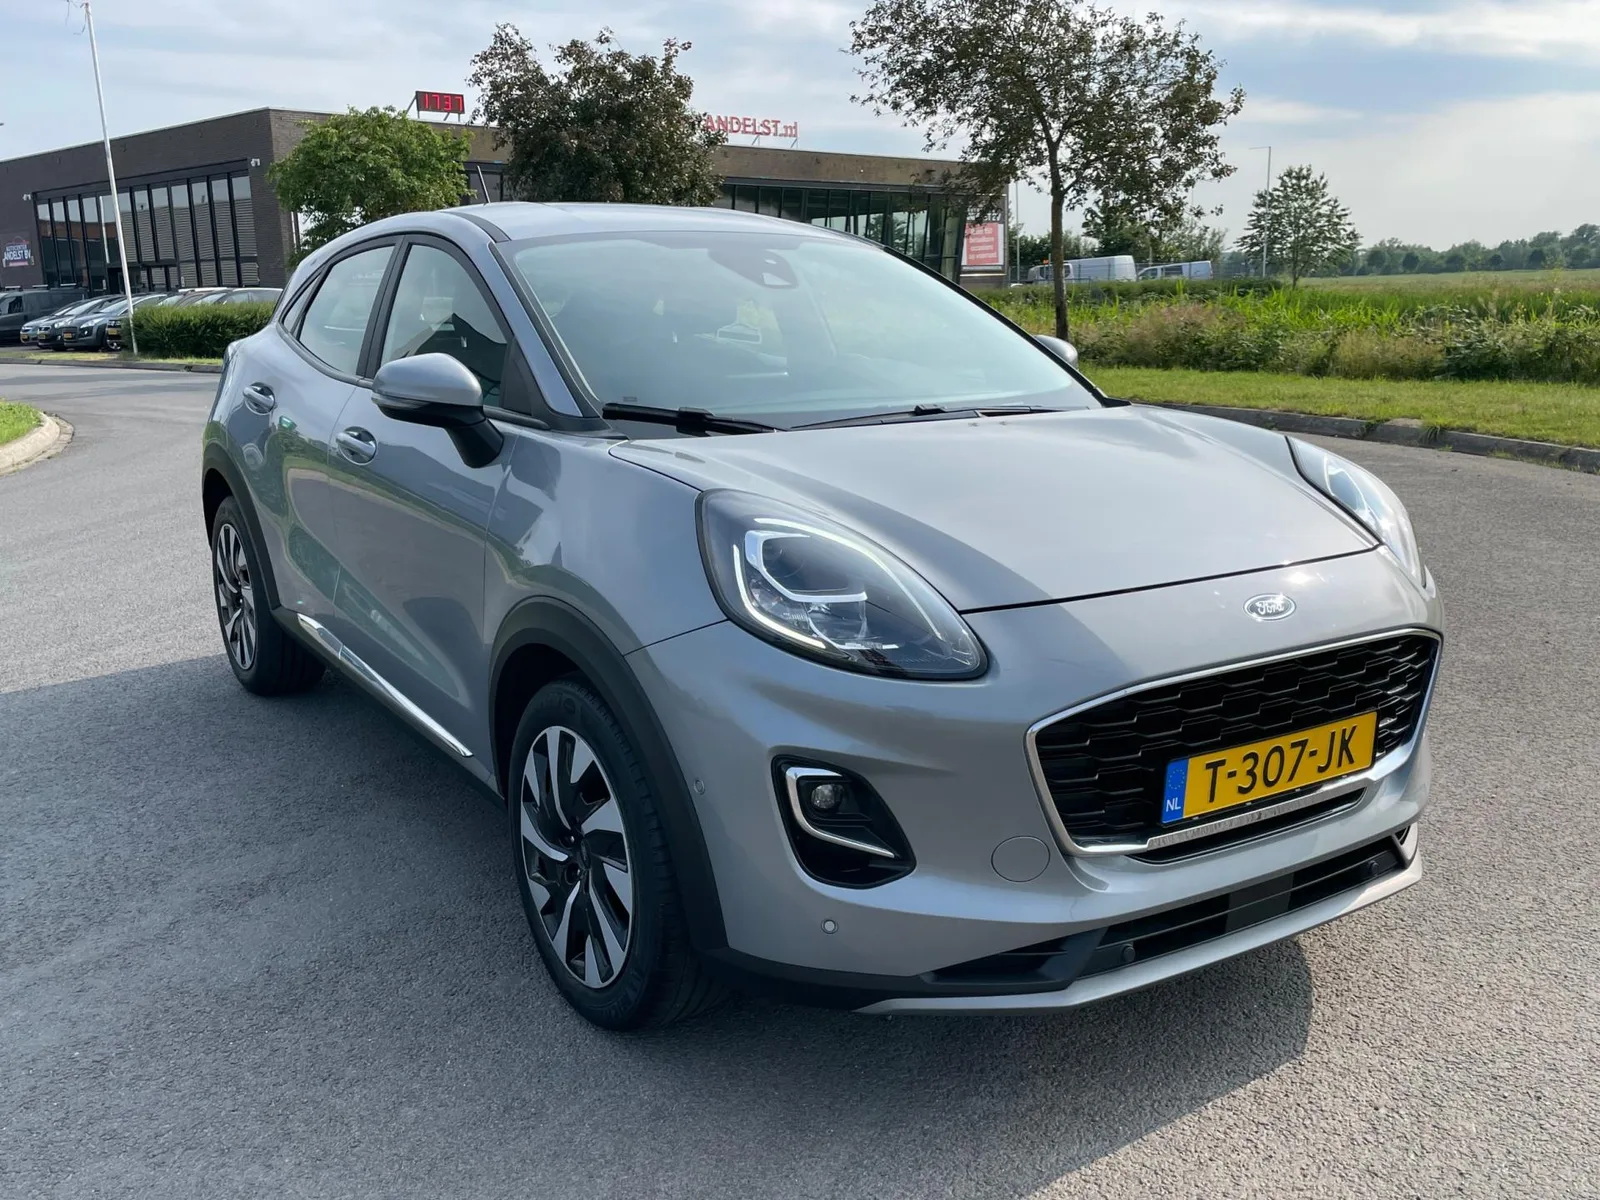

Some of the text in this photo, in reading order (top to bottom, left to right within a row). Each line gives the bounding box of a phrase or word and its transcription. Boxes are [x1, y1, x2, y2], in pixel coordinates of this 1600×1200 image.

[1255, 597, 1284, 615] Ford
[1205, 725, 1358, 803] T-307-JK
[1166, 797, 1181, 812] NL
